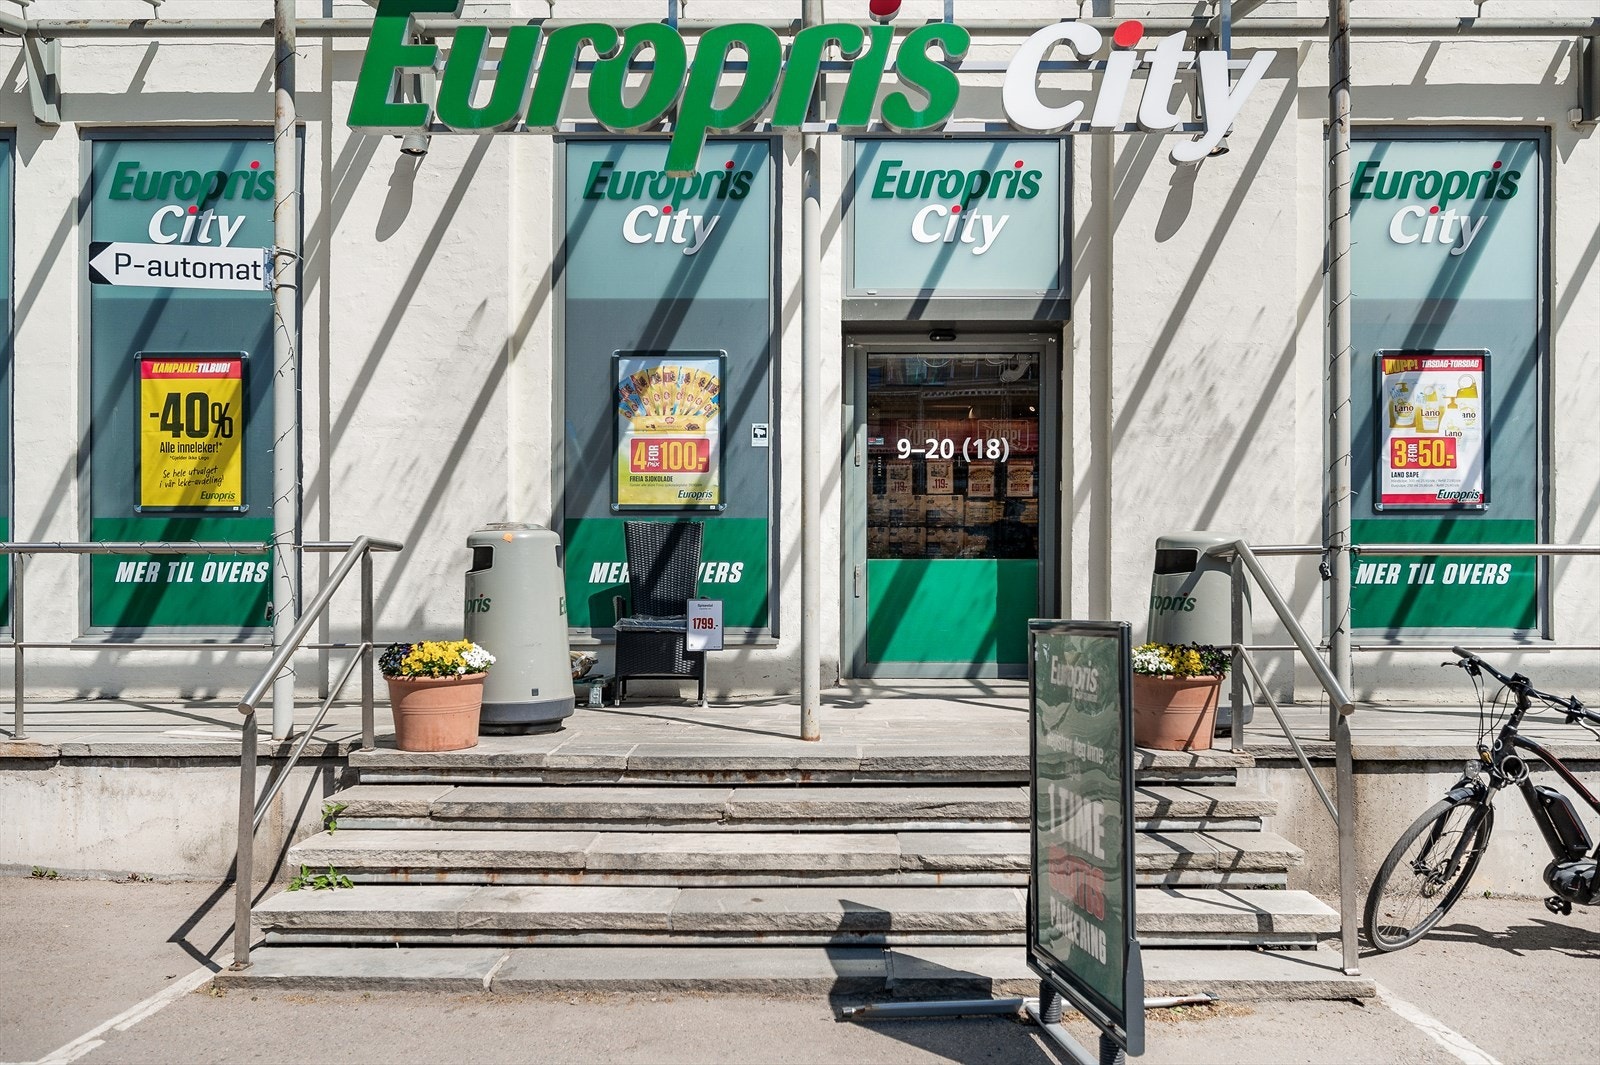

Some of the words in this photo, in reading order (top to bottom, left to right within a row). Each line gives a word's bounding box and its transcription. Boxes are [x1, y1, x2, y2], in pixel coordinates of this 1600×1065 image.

[347, 0, 971, 178] Europris
[1002, 20, 1276, 165] City
[109, 161, 276, 212] Europris
[583, 160, 754, 212] Europris
[871, 160, 1043, 211] Europris
[1350, 160, 1522, 212] Europris
[148, 205, 246, 248] City
[622, 205, 721, 256] City
[911, 203, 1010, 256] City
[1389, 205, 1489, 256] City
[114, 252, 263, 281] P-automat
[150, 392, 234, 438] -40%
[1394, 404, 1414, 413] Lano
[1420, 408, 1440, 417] Lano
[160, 441, 175, 453] Alle
[634, 442, 647, 470] 4
[648, 445, 659, 461] FOR
[963, 437, 1009, 462] (18)
[1394, 439, 1407, 467] 3
[172, 469, 186, 477] hele
[200, 490, 236, 502] Europris
[678, 489, 713, 501] Europris
[1436, 488, 1480, 502] Europris
[115, 561, 161, 583] MER
[166, 561, 195, 583] TIL
[201, 561, 270, 583] OVERS
[1354, 563, 1402, 585] MER
[1407, 563, 1436, 585] TIL
[1442, 563, 1512, 585] OVERS
[692, 617, 719, 630] 1799.-
[1059, 786, 1105, 861] TIME
